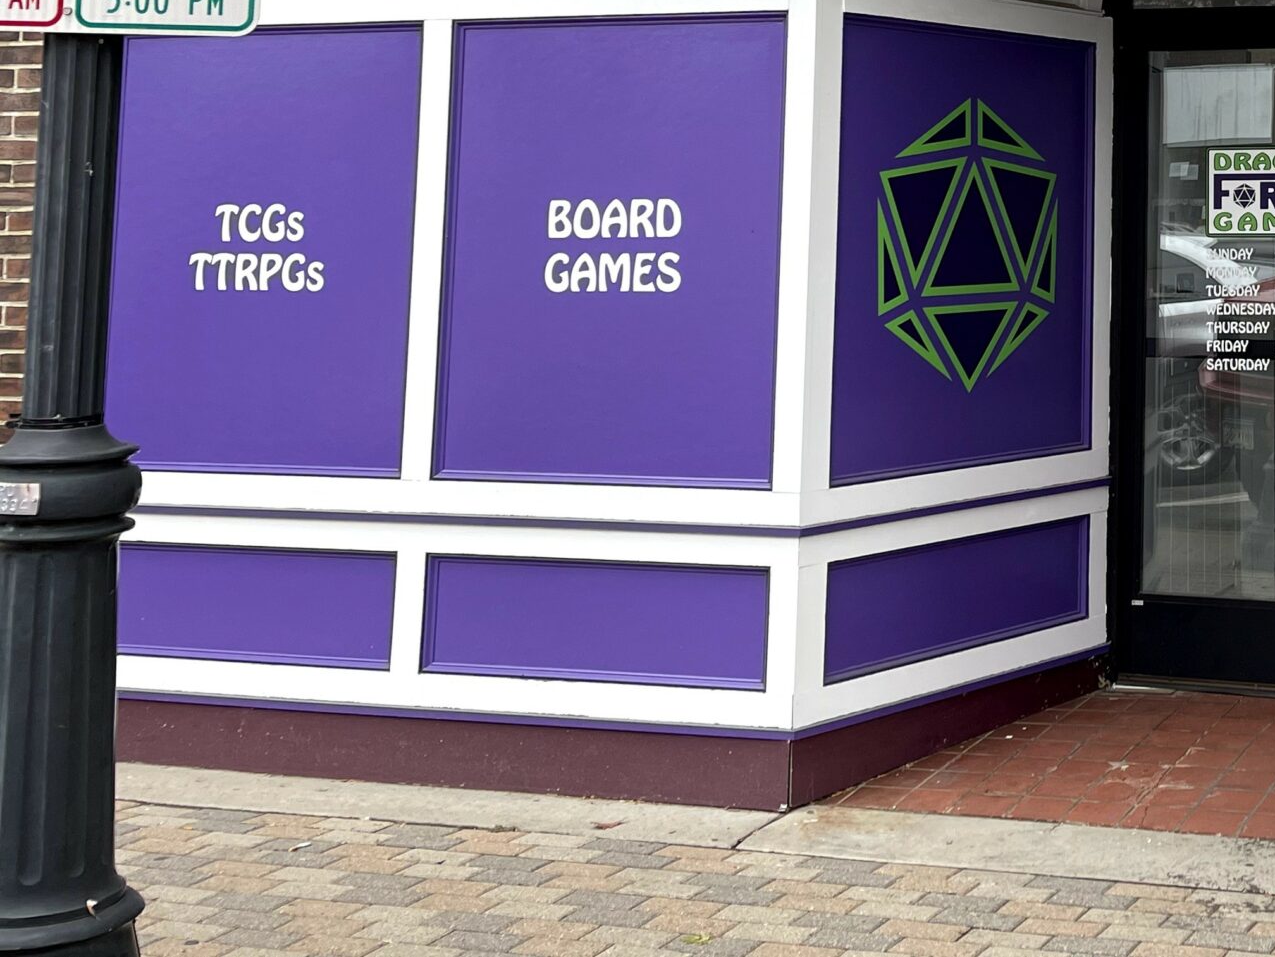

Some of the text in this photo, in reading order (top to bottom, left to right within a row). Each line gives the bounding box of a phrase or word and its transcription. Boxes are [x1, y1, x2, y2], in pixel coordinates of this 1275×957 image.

[215, 203, 305, 243] TCGs
[546, 197, 683, 239] BOARD
[1206, 247, 1254, 261] SUNDAY
[188, 252, 325, 293] TTRPGs
[543, 251, 682, 293] GAMES
[1205, 266, 1257, 279] MONDAY
[1205, 284, 1260, 297] TUESDAY
[1206, 321, 1271, 334] THURSDAY
[1206, 339, 1249, 353] FRIDAY
[1206, 358, 1271, 371] SATURDAY
